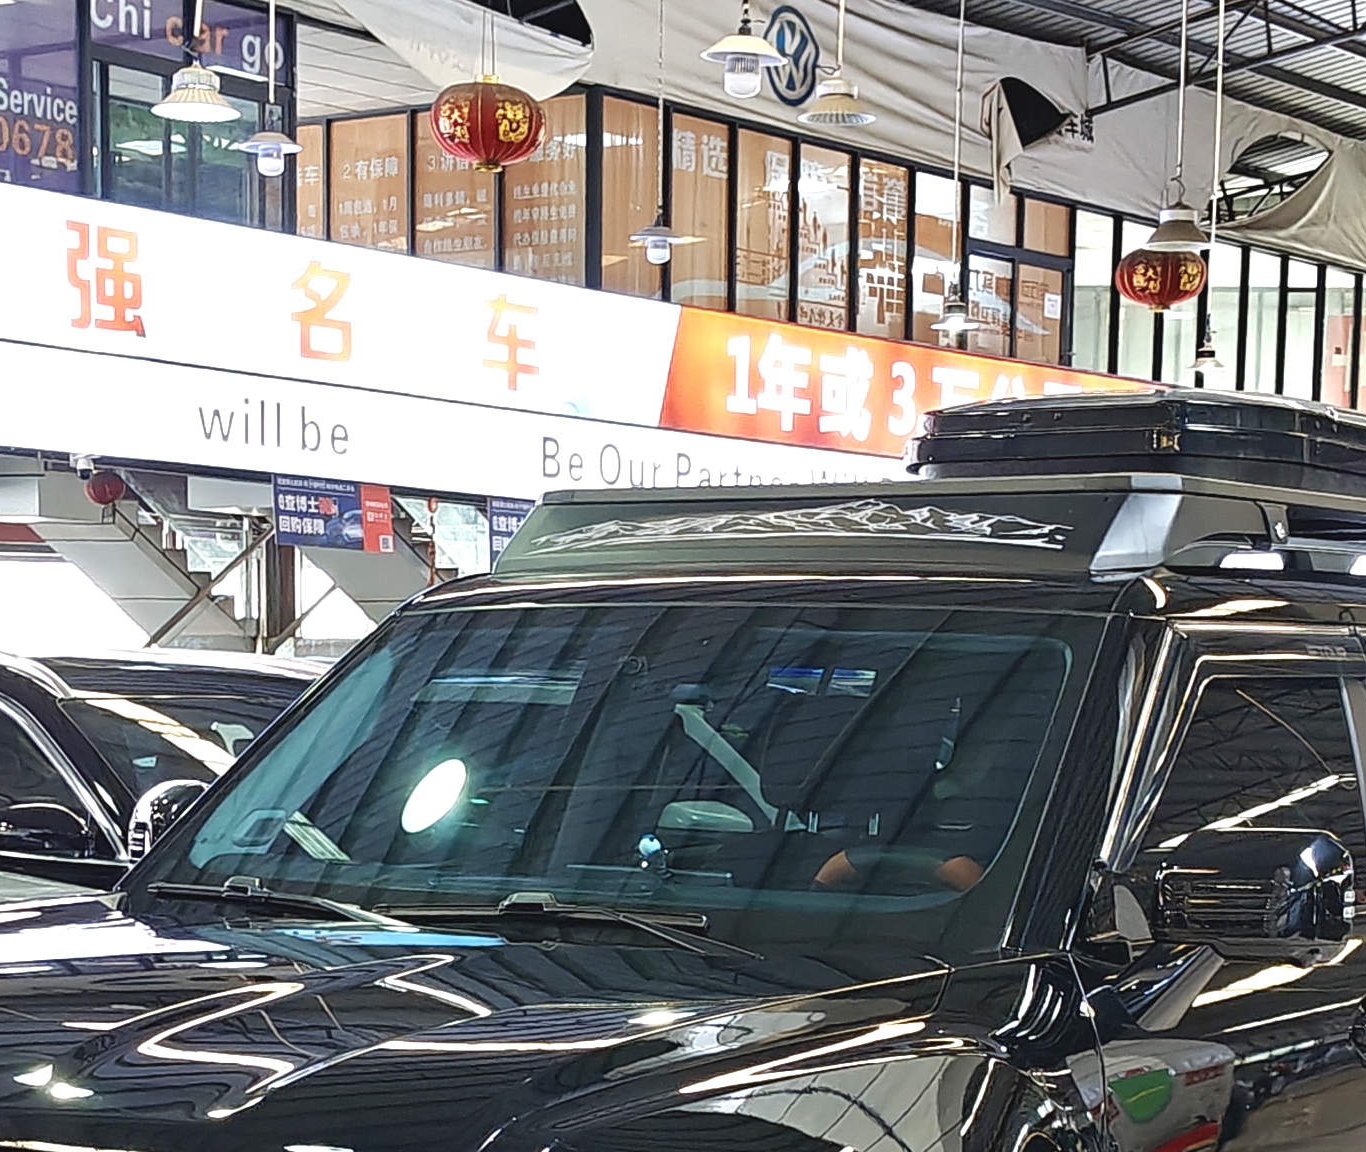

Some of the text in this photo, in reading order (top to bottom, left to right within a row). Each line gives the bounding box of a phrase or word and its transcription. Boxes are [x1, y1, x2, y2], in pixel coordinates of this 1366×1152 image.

[198, 401, 283, 450] will
[300, 415, 350, 456] be
[541, 435, 584, 482] Be
[599, 443, 662, 489] Our
[278, 514, 325, 536] 回购保障
